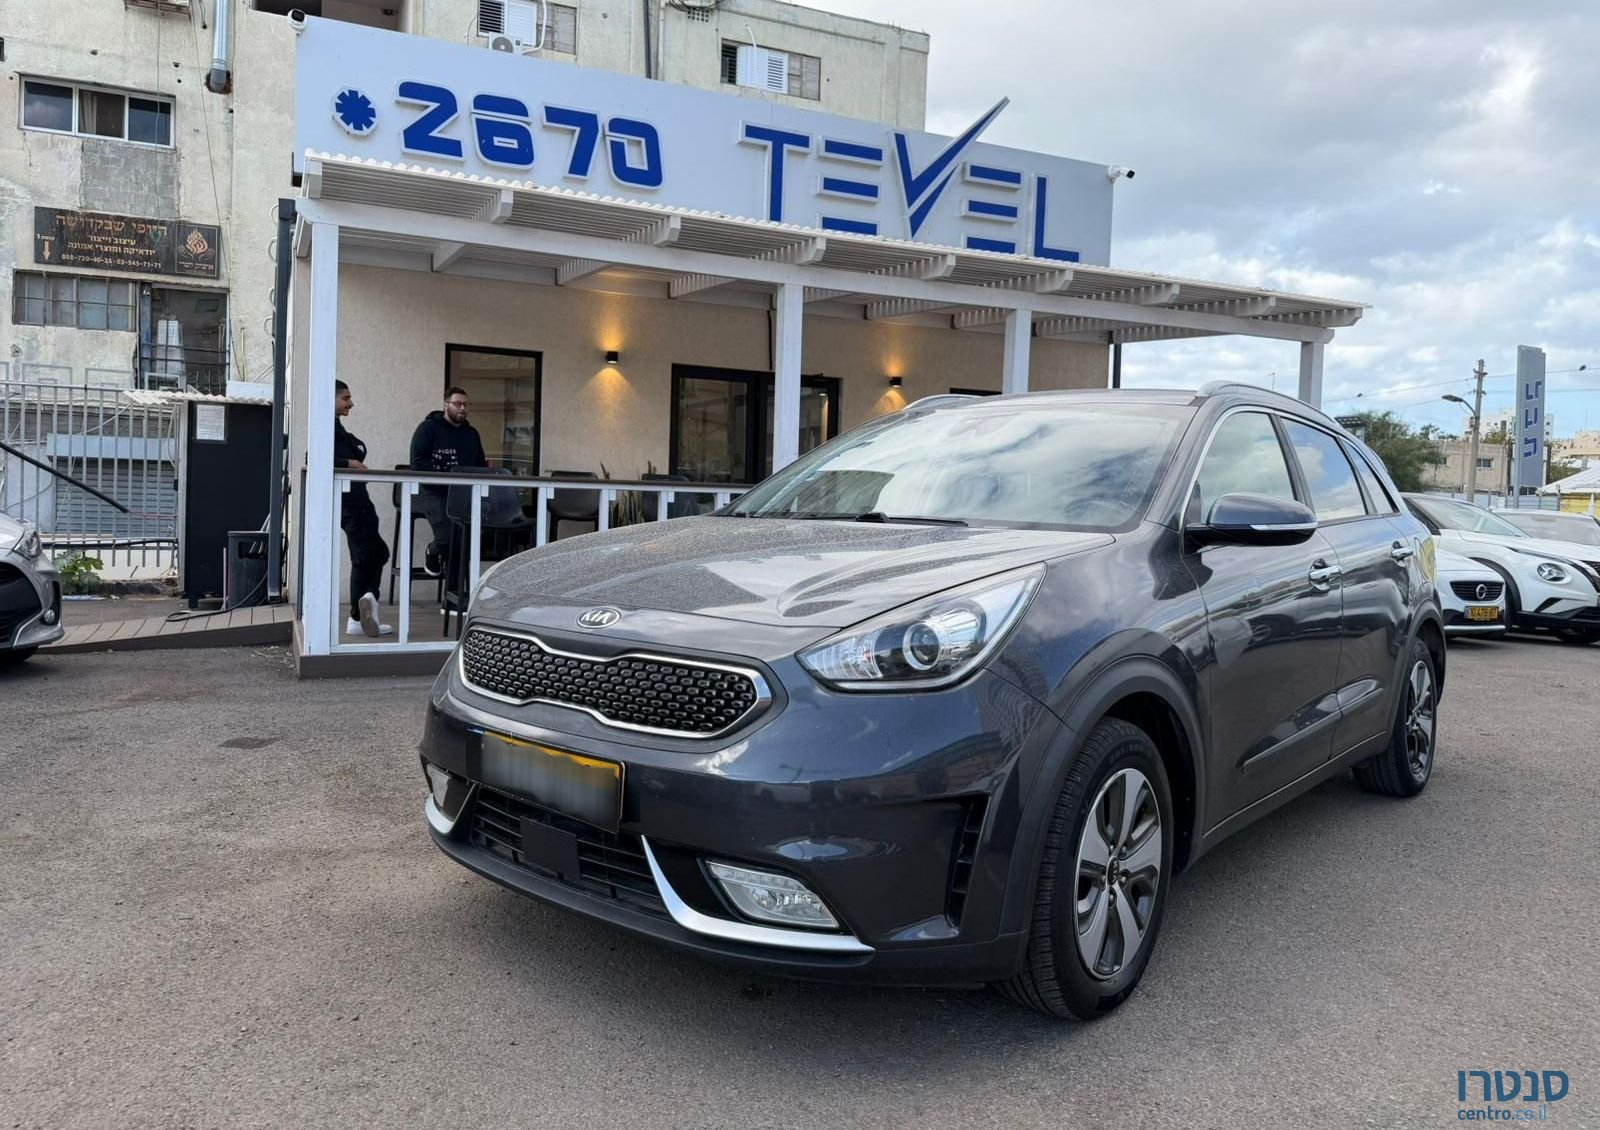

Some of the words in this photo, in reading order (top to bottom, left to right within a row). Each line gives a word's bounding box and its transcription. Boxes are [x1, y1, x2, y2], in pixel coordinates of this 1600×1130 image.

[398, 81, 663, 187] 2670
[744, 96, 1080, 263] TEVEL
[112, 237, 136, 245] עיצוב
[580, 610, 612, 624] KIA
